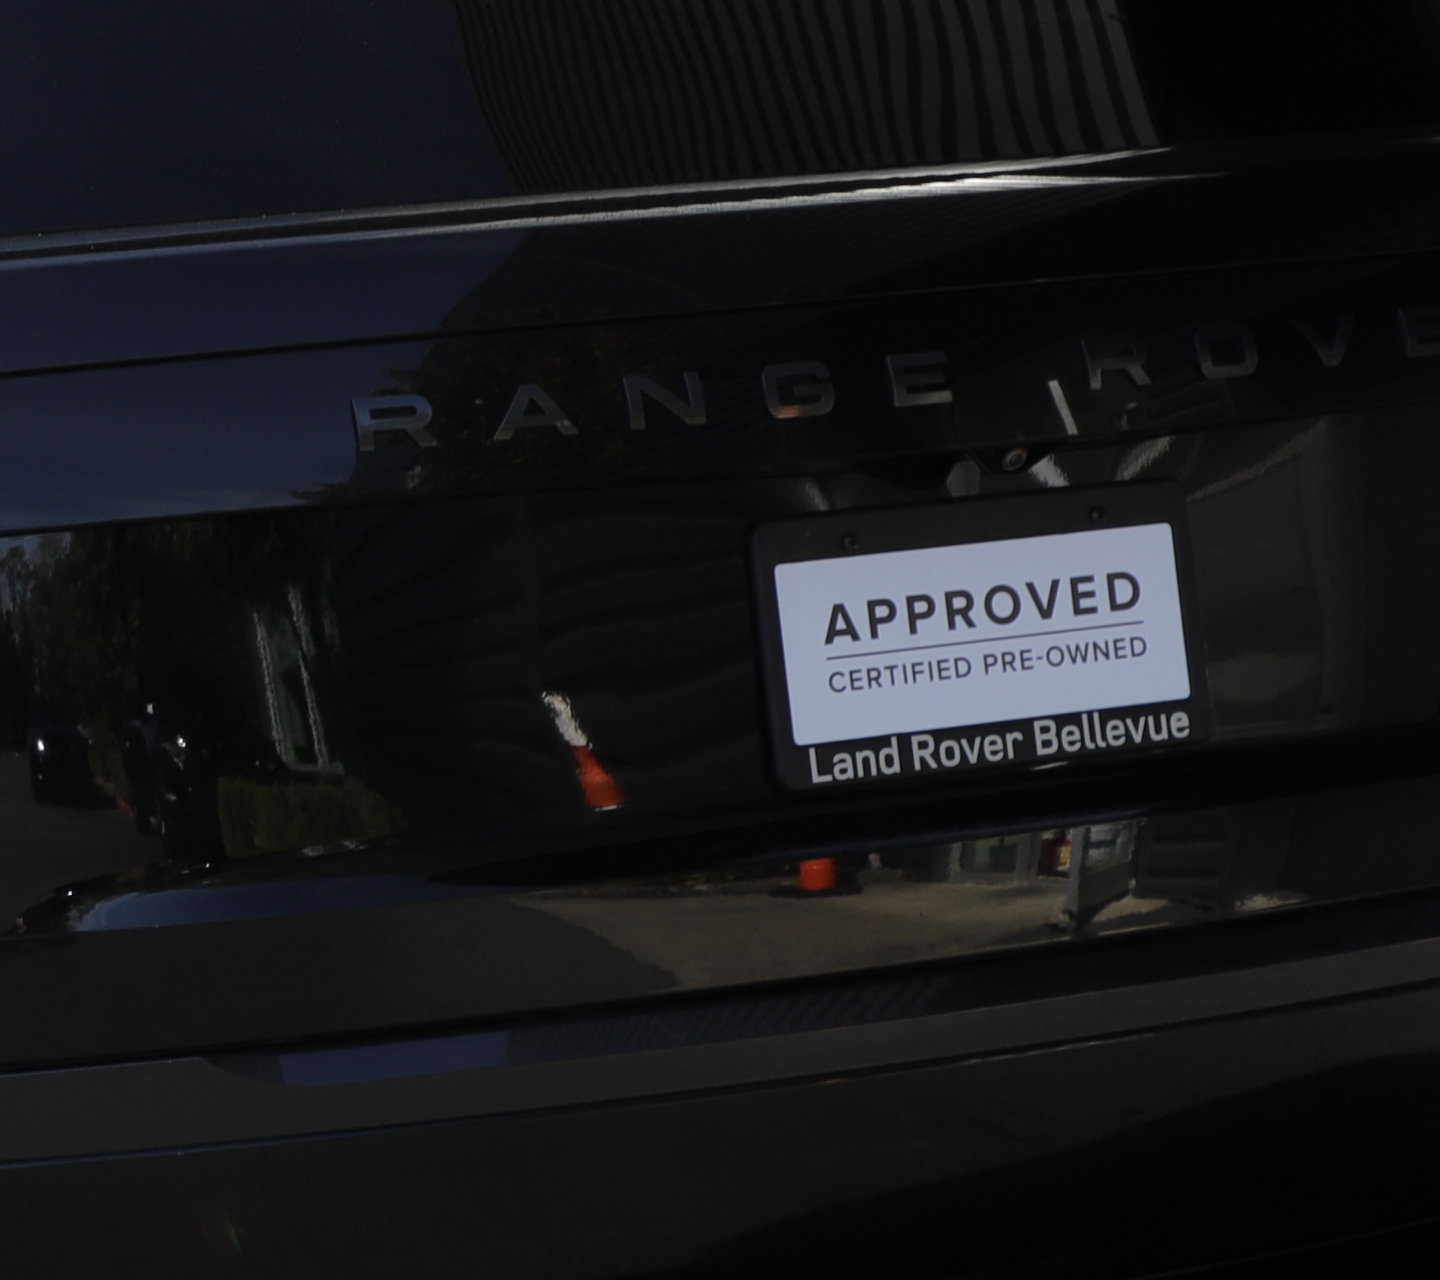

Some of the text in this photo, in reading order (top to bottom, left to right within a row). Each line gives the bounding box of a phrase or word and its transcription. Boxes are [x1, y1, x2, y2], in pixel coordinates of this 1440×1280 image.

[350, 350, 953, 454] RANGE
[824, 571, 1141, 645] APPROVED
[827, 635, 1148, 694] CERTIFIED PRE-OWNED
[808, 710, 1191, 784] Land Rover Bellevue
